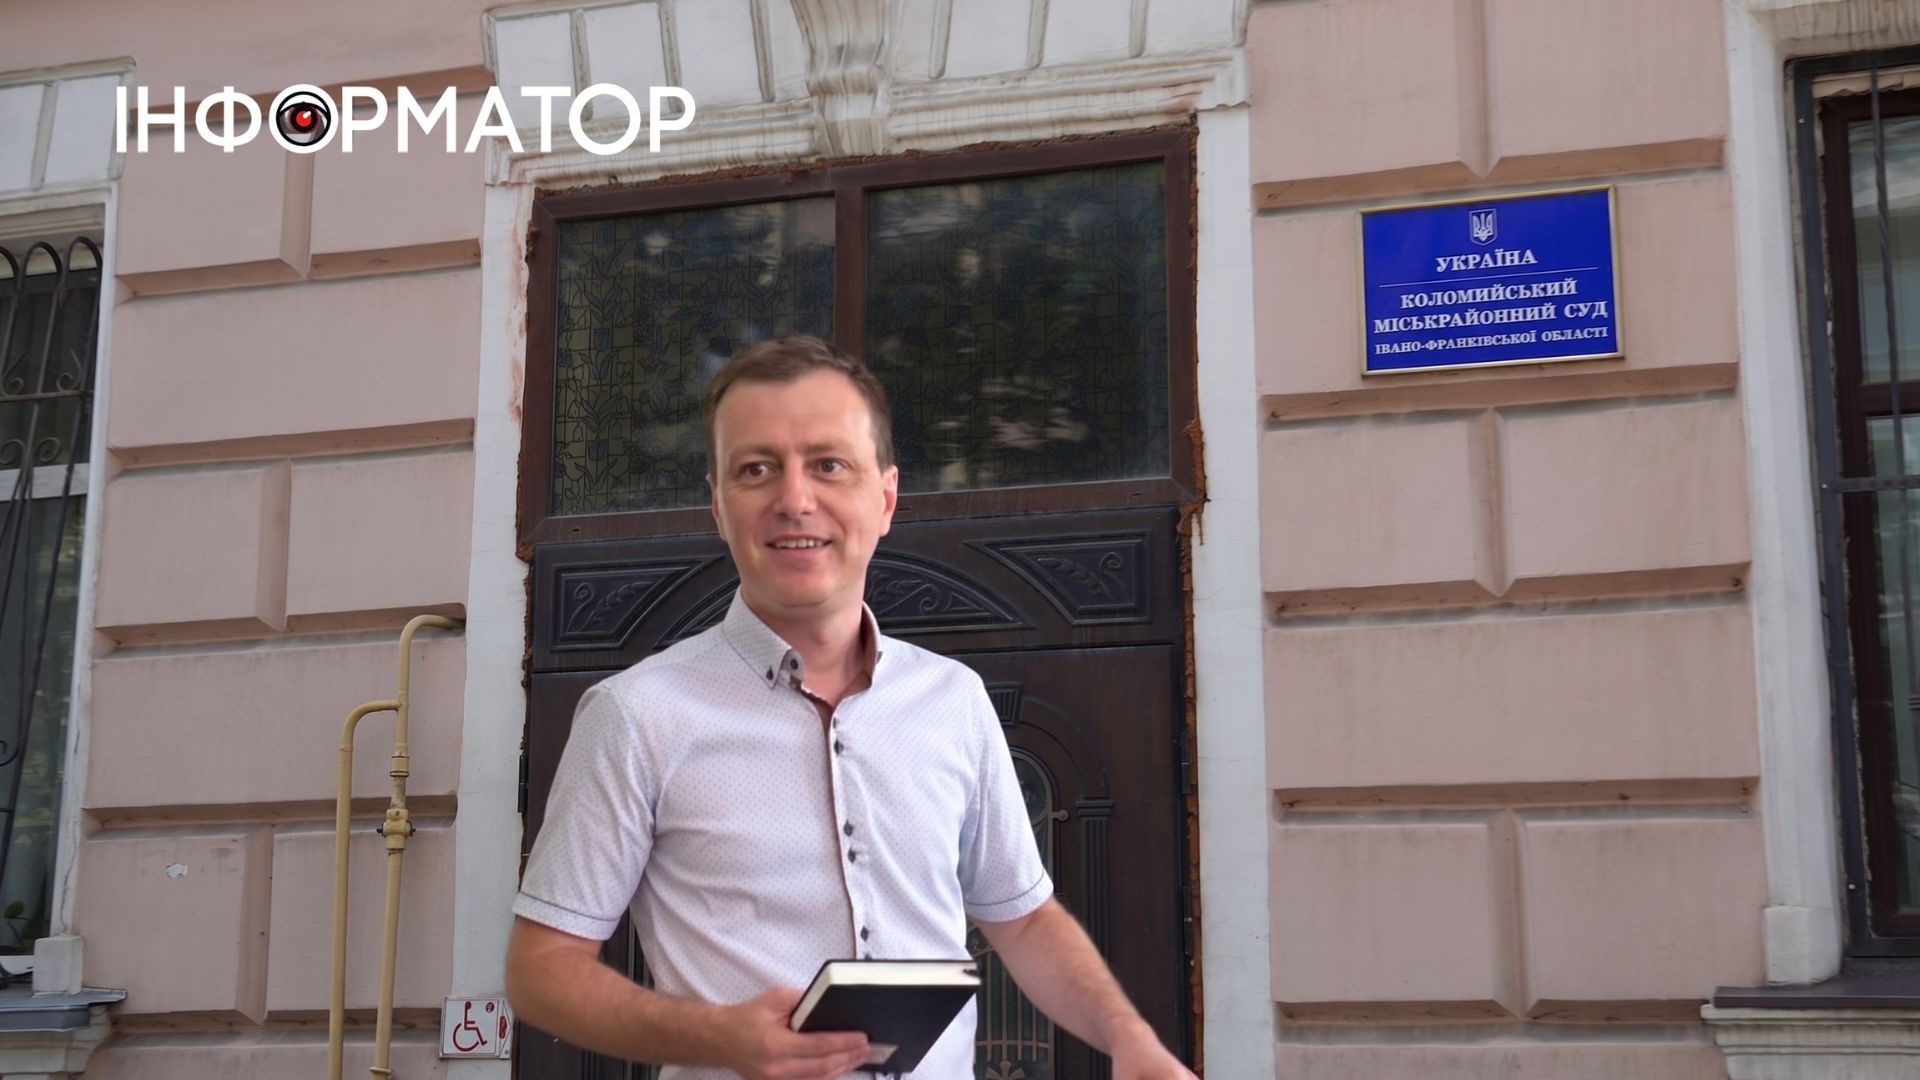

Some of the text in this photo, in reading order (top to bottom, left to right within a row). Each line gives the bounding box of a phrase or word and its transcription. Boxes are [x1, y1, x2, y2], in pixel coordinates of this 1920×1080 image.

[1436, 249, 1537, 272] УКРАЇНА
[1400, 279, 1577, 308] КОЛОМИЙСЬКИЙ
[1374, 301, 1608, 333] МІСЬКРАЙОННИЙ СУД
[1375, 327, 1608, 354] ІВАНО-ФРАНКІВСЬКОЇ ОБЛАСТІ
